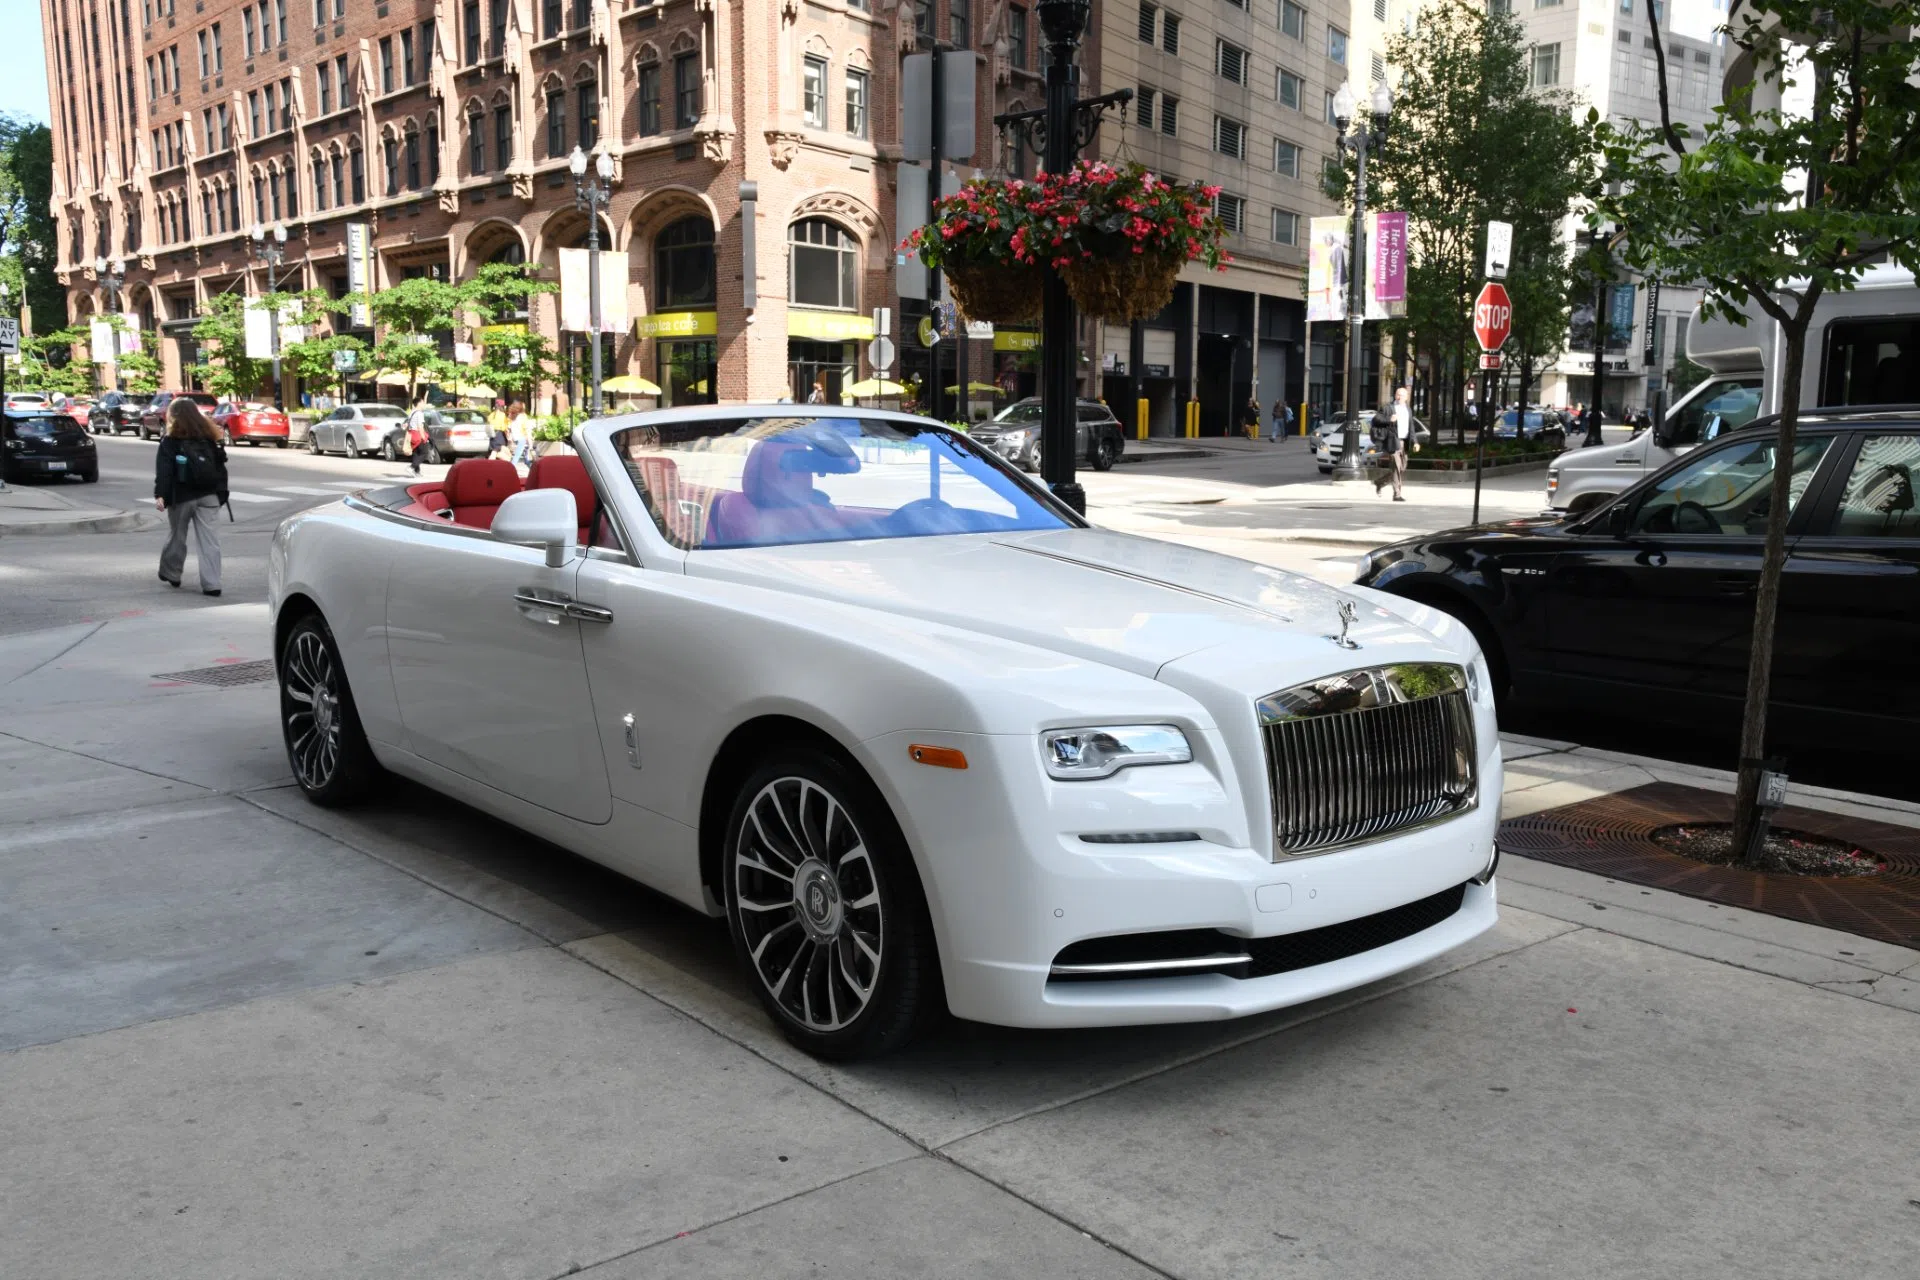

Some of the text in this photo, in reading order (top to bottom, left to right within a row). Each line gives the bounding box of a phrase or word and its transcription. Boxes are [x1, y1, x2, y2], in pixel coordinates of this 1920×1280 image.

[1391, 228, 1401, 248] Her
[1378, 229, 1390, 284] My Dreams
[1, 320, 14, 330] NE
[1477, 303, 1509, 330] STOP
[0, 330, 15, 340] AY
[1645, 329, 1654, 351] rack
